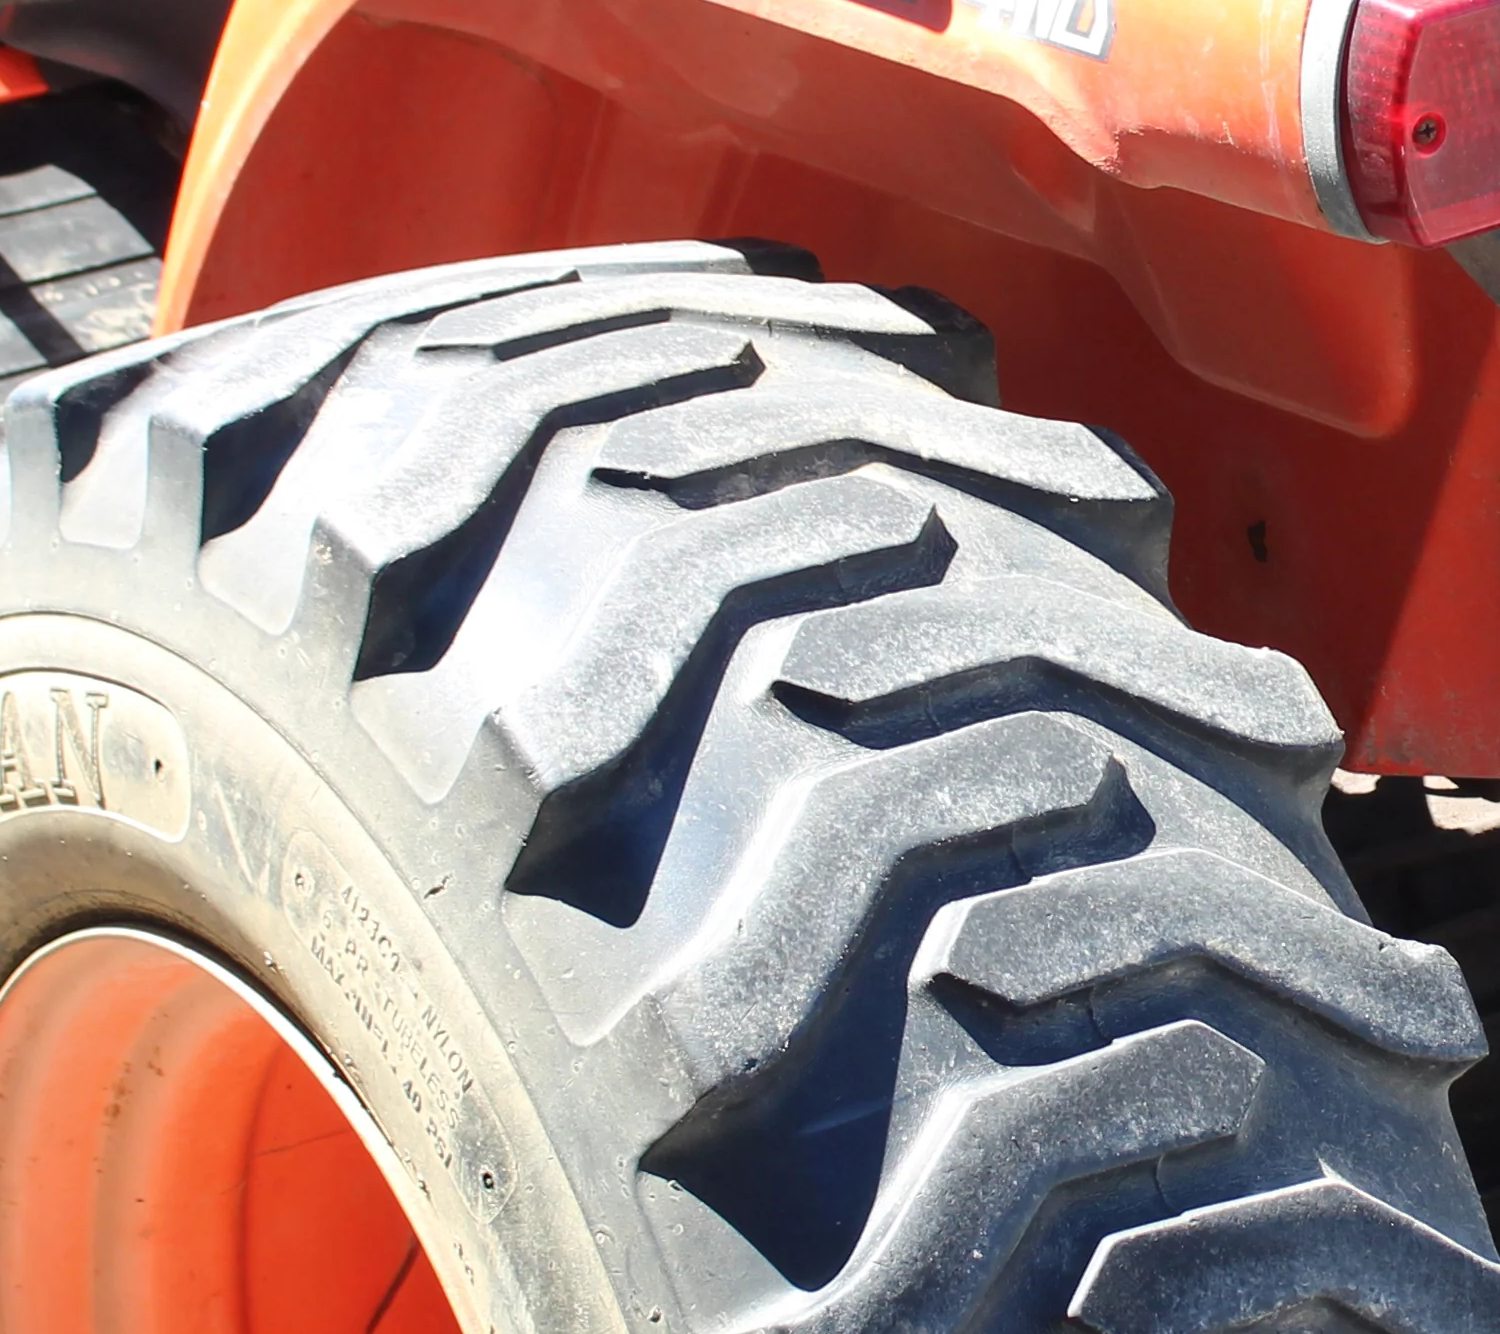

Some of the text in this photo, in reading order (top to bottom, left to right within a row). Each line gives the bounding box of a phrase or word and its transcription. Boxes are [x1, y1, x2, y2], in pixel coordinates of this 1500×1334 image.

[381, 991, 461, 1131] TUBELESS
[420, 1006, 475, 1095] NYLON
[425, 1122, 454, 1170] PSI
